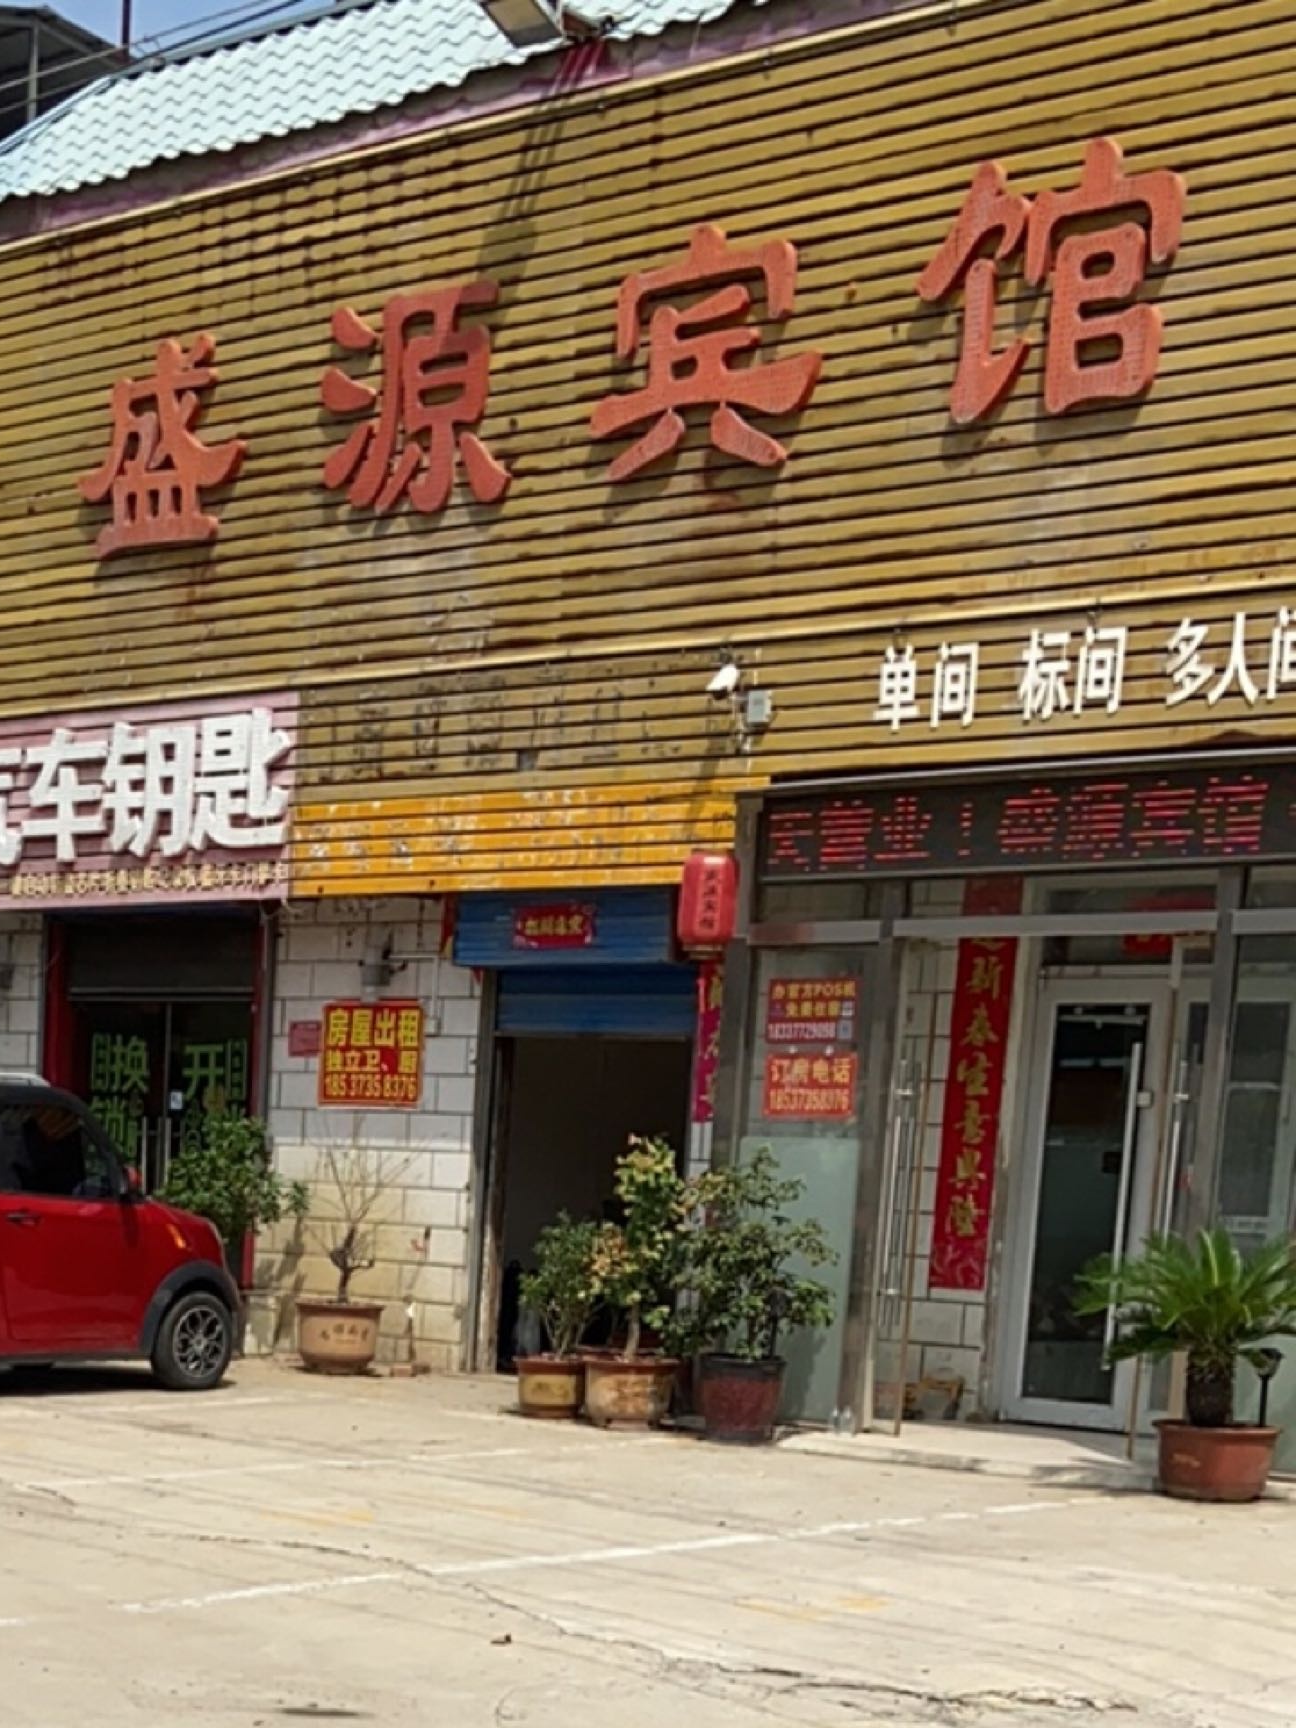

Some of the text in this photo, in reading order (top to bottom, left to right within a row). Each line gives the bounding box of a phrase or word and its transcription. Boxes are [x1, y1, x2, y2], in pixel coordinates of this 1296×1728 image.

[78, 137, 1186, 558] 盛源宾馆
[873, 641, 980, 731] 单间
[1019, 626, 1129, 721] 标间
[328, 1009, 420, 1047] 房屋出租
